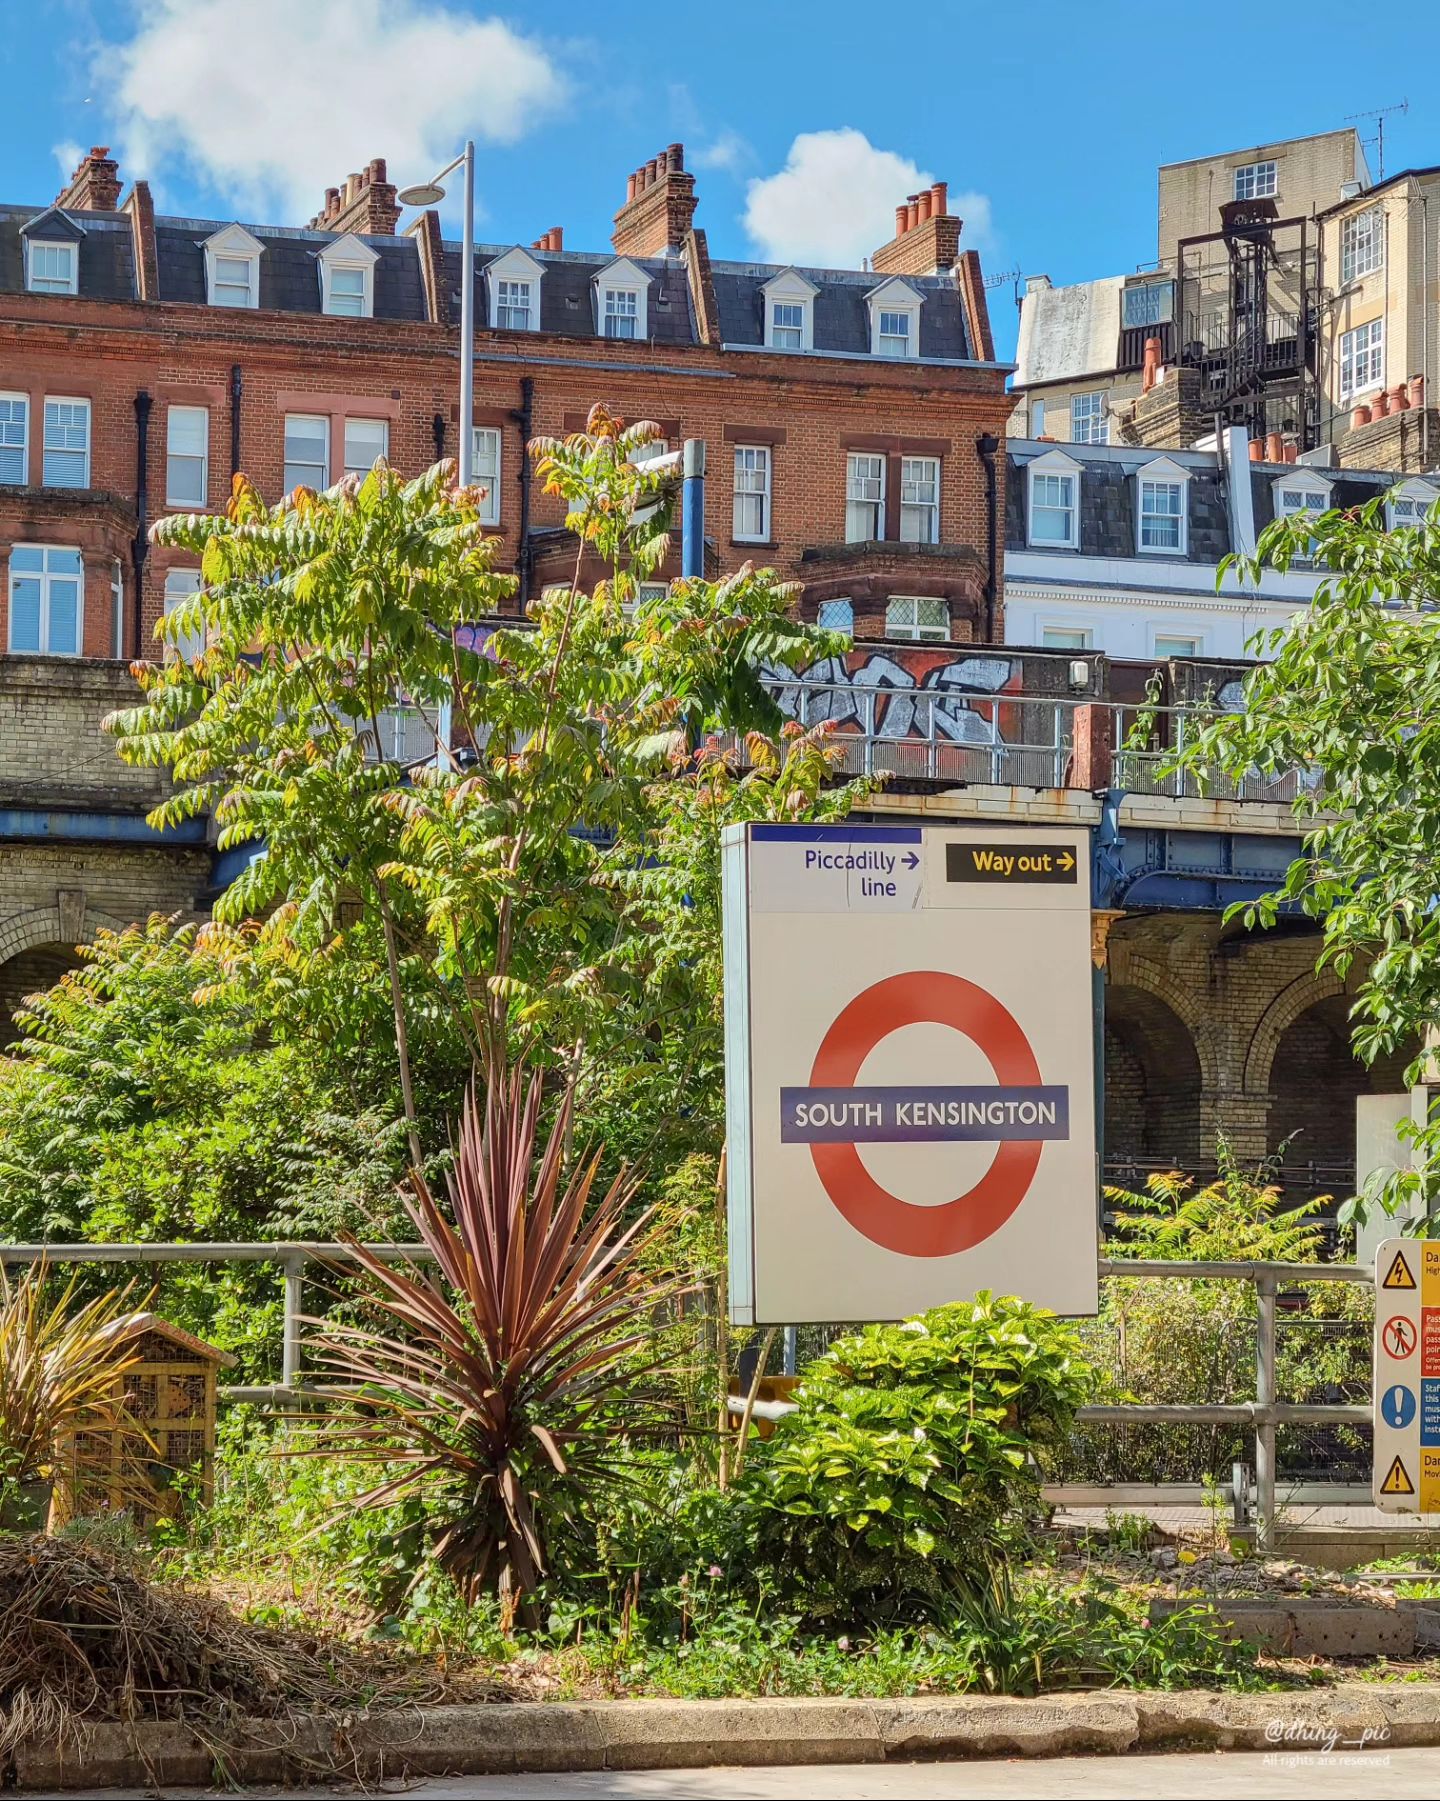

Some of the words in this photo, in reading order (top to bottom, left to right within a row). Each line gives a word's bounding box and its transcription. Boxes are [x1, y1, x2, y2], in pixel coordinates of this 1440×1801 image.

[805, 850, 896, 874] Piccadilly
[972, 851, 1014, 875] Way
[1017, 854, 1052, 872] out
[861, 877, 897, 896] line
[795, 1103, 882, 1127] SOUTH
[896, 1101, 1056, 1126] KENSINGTON
